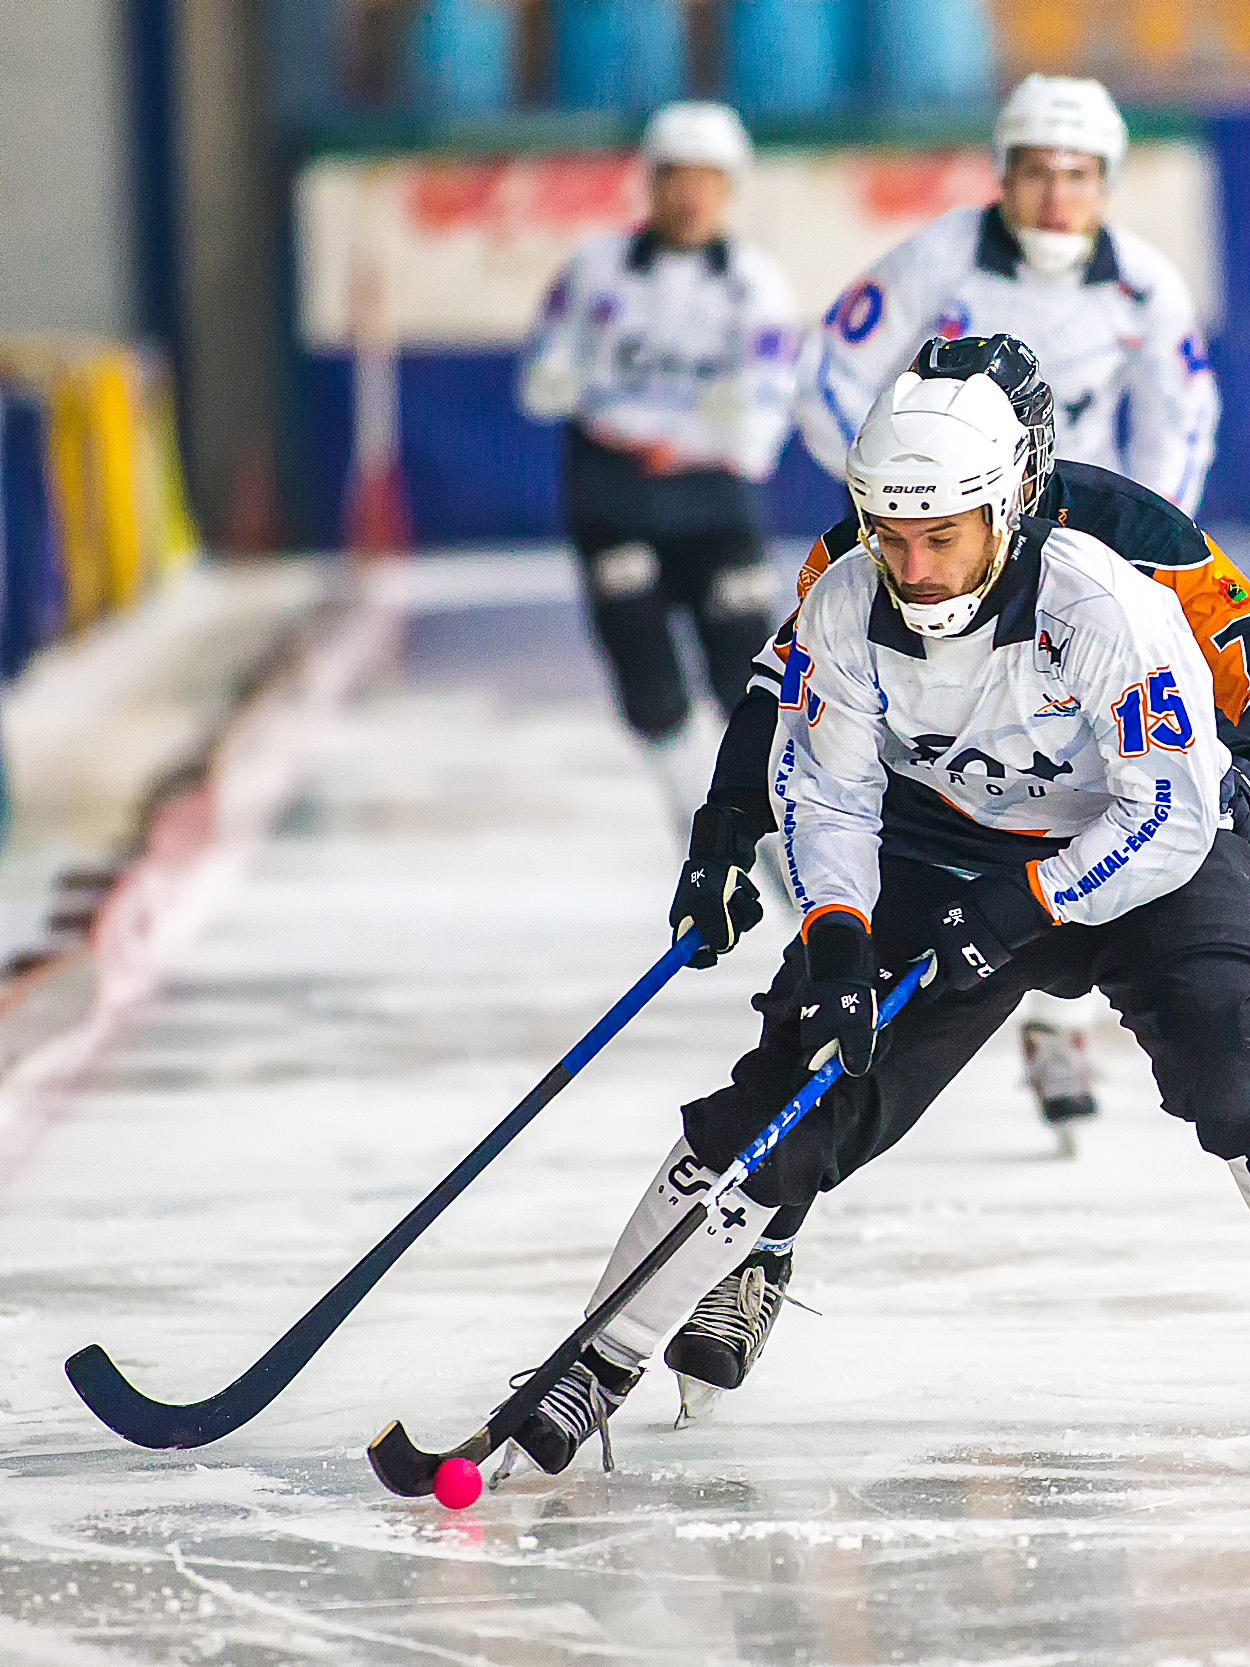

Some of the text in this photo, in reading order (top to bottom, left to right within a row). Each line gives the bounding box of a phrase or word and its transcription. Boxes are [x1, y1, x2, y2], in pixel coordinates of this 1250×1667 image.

[883, 485, 937, 494] BAUER
[1111, 664, 1195, 758] 15
[658, 1185, 733, 1244] GRUP
